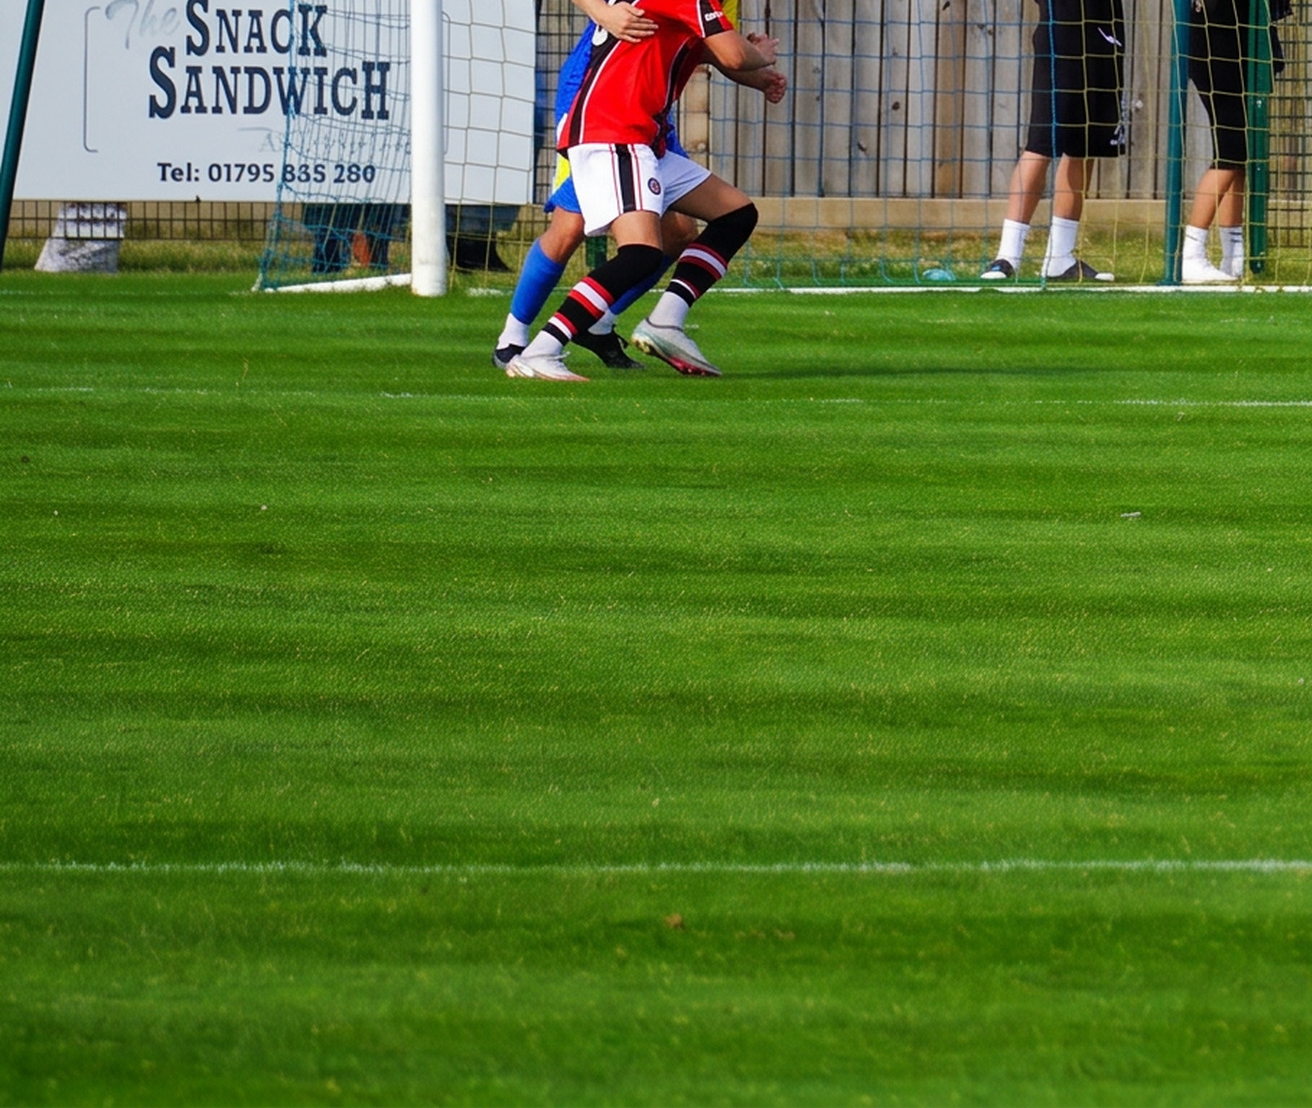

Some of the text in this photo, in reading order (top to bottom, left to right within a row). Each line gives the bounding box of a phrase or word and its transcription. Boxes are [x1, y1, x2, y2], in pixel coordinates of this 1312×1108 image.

[148, 45, 391, 120] SANDWICH
[157, 162, 200, 183] Tel:
[208, 162, 275, 184] 01795
[334, 164, 377, 185] 280
